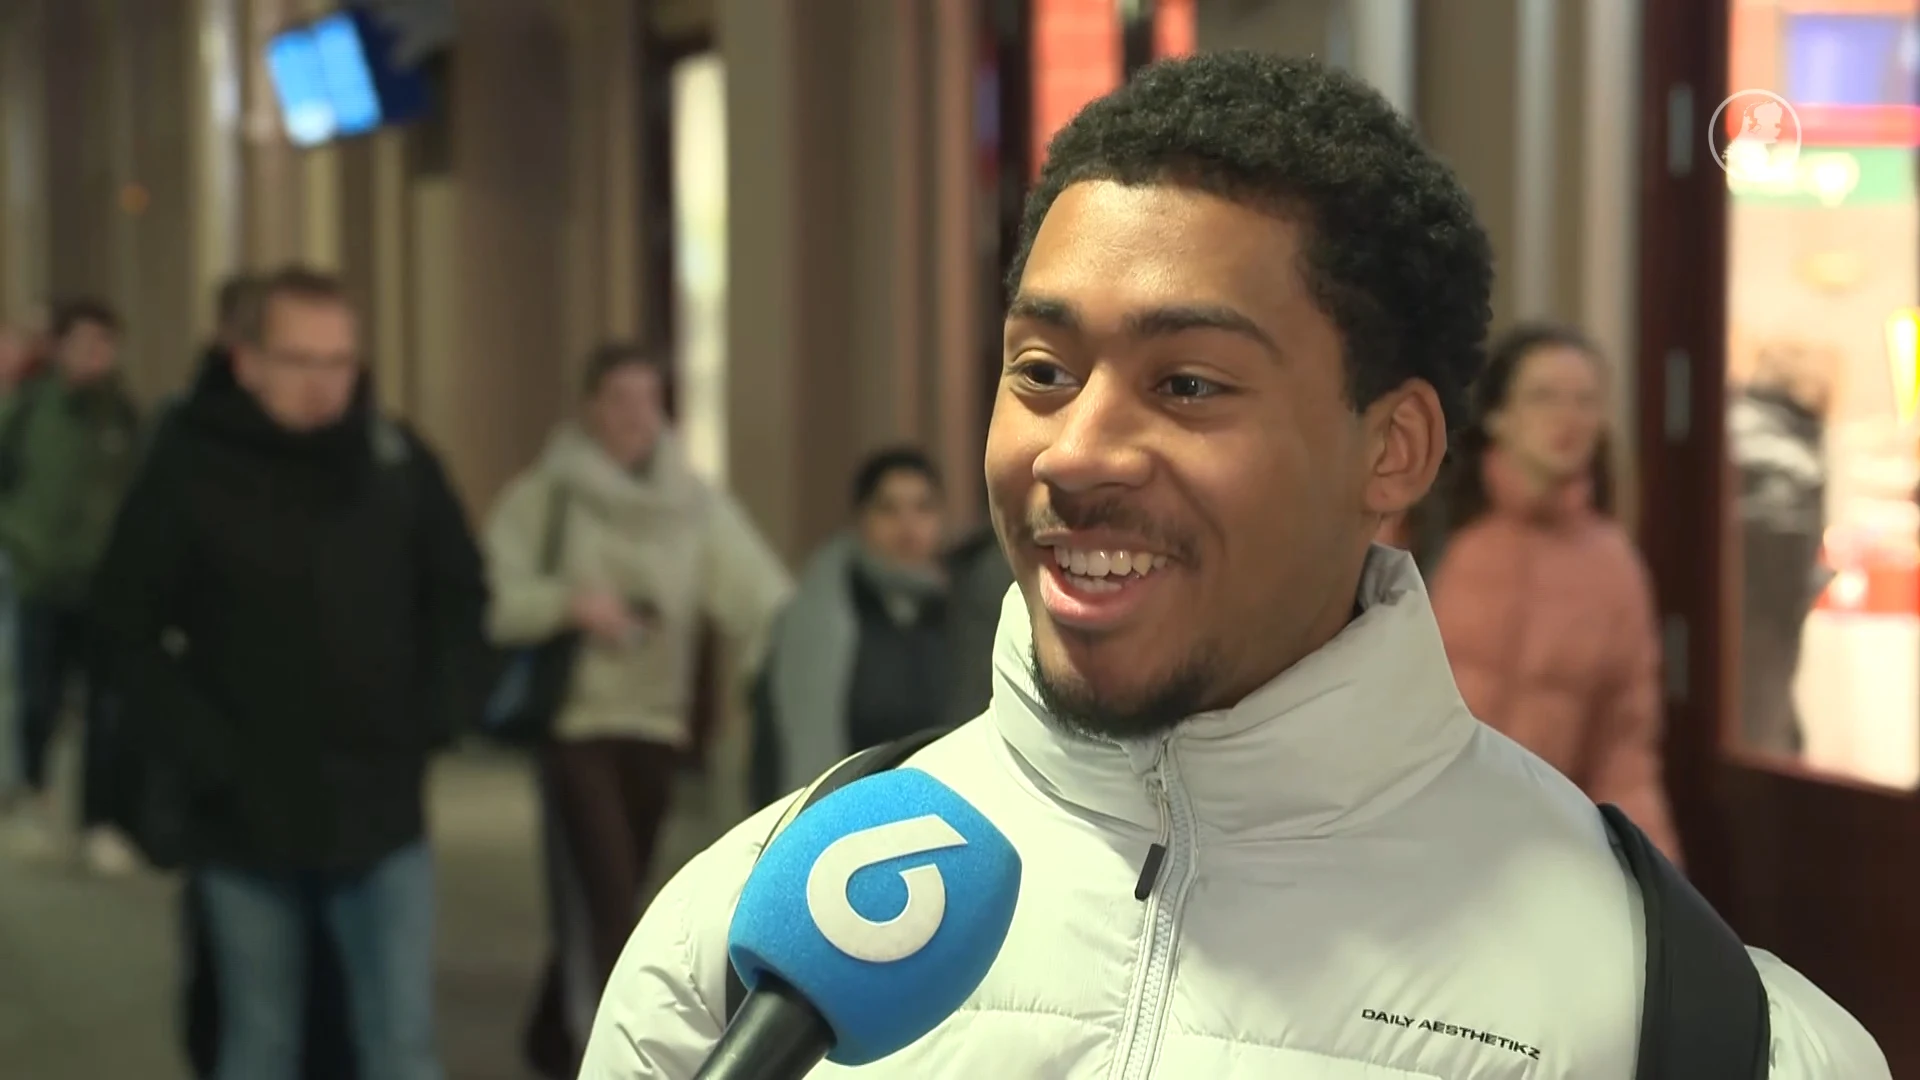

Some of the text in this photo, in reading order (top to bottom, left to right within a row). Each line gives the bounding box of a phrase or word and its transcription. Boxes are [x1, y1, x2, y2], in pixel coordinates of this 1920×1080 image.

[806, 813, 968, 963] 6
[1361, 1008, 1541, 1060] DAILY AESTHETIKZ
